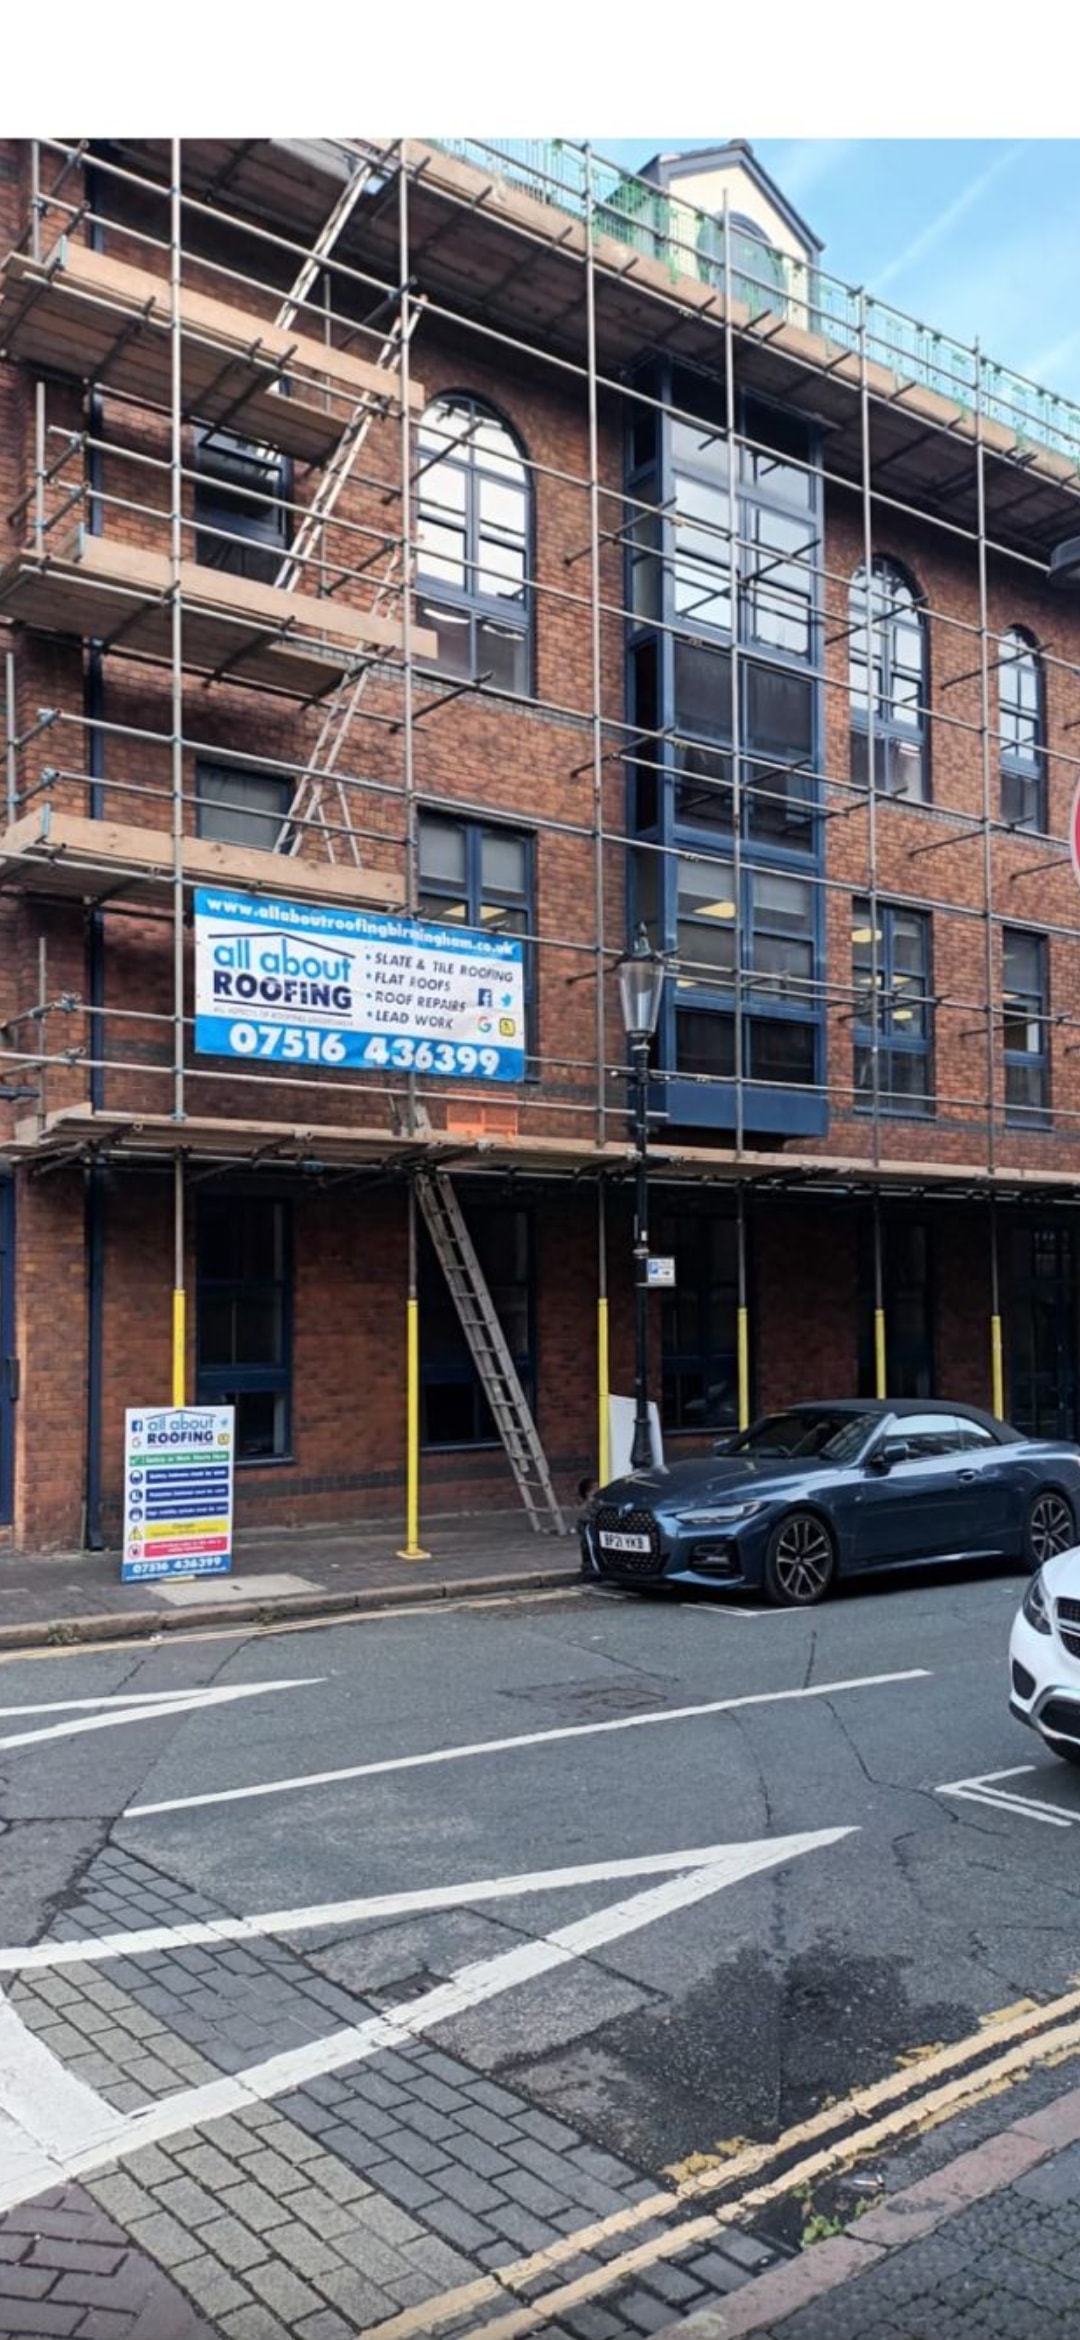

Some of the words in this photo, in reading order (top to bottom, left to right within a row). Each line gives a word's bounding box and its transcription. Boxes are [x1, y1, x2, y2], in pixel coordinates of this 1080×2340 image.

[206, 897, 514, 955] www.allaboutroofingbirmingham.co.uk
[213, 939, 250, 969] all
[259, 937, 352, 982] about
[374, 952, 412, 968] SLATE
[415, 959, 425, 970] &
[432, 961, 454, 975] TILE
[460, 964, 513, 983] ROOFING
[213, 970, 352, 1010] ROOFING
[374, 972, 404, 987] FLAT
[374, 991, 412, 1005] ROOF
[416, 996, 466, 1012] REPAIRS
[374, 1010, 409, 1024] LEAD
[415, 1015, 453, 1030] WORK
[229, 1021, 347, 1062] 07516
[363, 1036, 500, 1075] 436399
[147, 1414, 166, 1431] all
[169, 1413, 214, 1430] about
[147, 1430, 213, 1444] ROOFING
